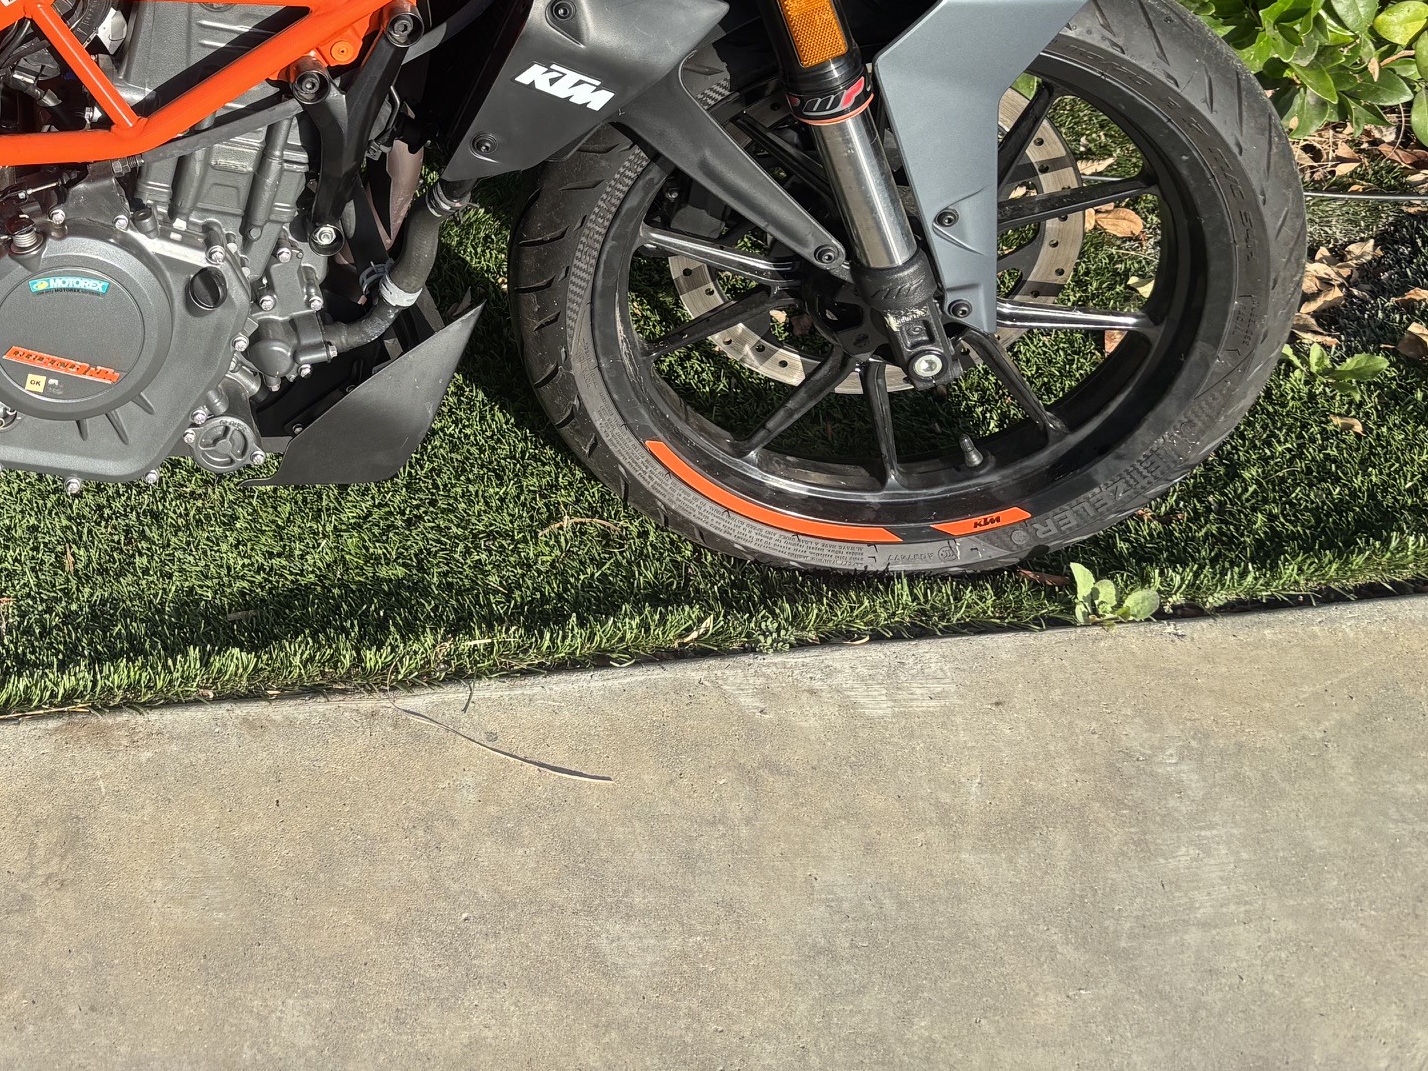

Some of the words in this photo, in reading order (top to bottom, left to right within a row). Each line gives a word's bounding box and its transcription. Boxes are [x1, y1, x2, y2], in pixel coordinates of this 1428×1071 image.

[514, 63, 616, 112] KTM
[802, 76, 865, 116] WP
[50, 276, 104, 293] MOTOREX
[29, 378, 42, 387] OK
[973, 515, 1001, 529] KTM
